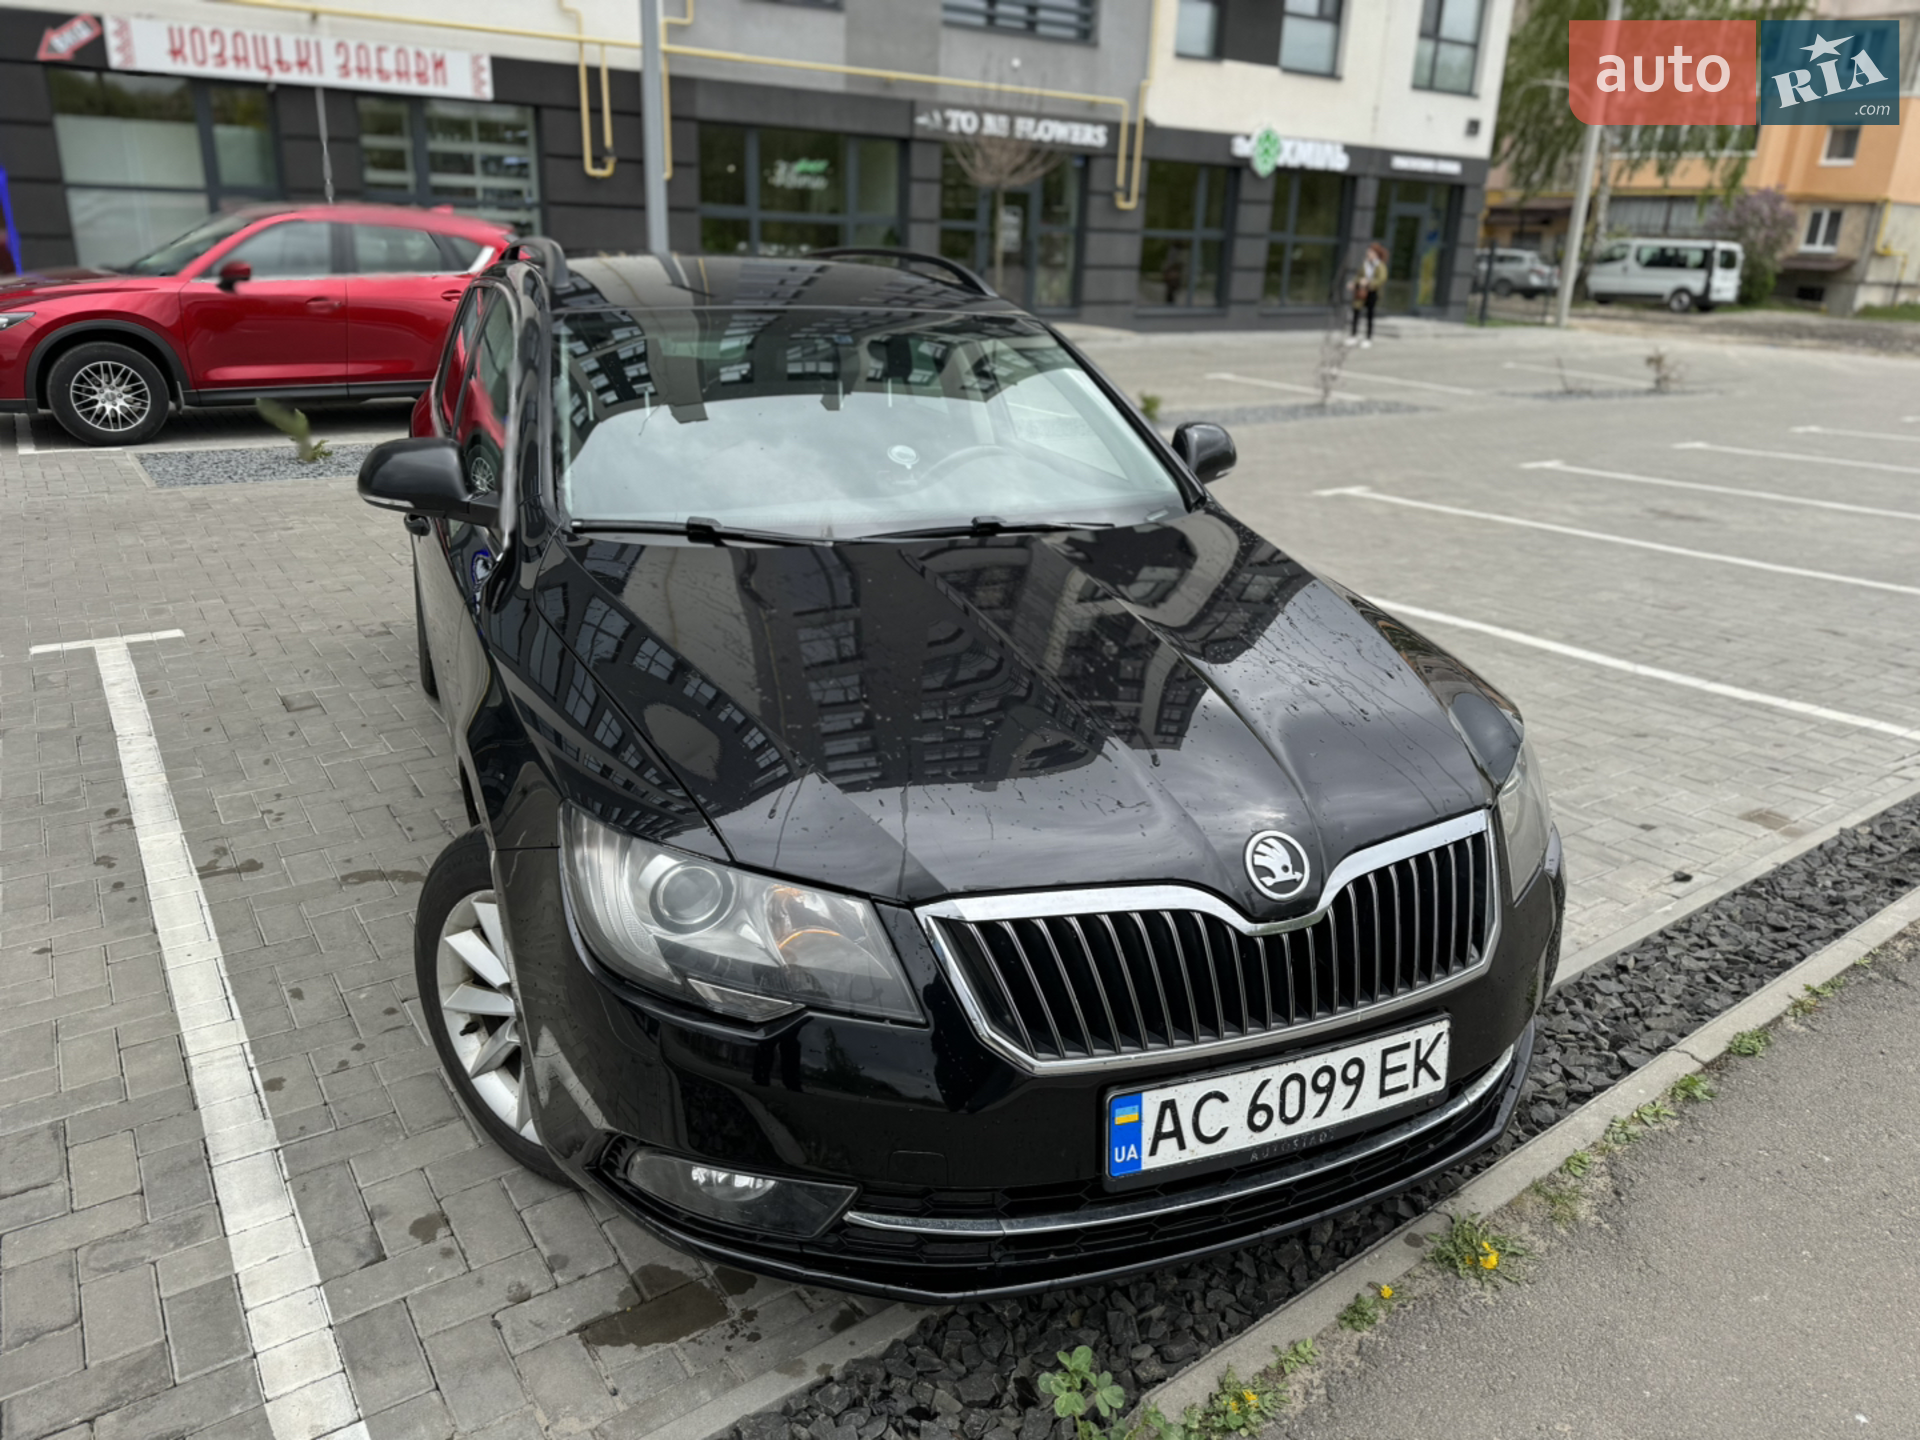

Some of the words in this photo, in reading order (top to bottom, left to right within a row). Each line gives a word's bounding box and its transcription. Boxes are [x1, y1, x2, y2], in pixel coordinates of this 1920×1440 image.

[168, 26, 324, 76] КОЗАЦЬКІ
[335, 41, 448, 87] ЗАБАВИ
[944, 108, 979, 135] TO
[1014, 116, 1108, 148] FLOWERS
[1147, 1090, 1230, 1157] AC
[1246, 1056, 1366, 1133] 6099
[1378, 1031, 1445, 1100] EK
[1114, 1144, 1139, 1163] UA
